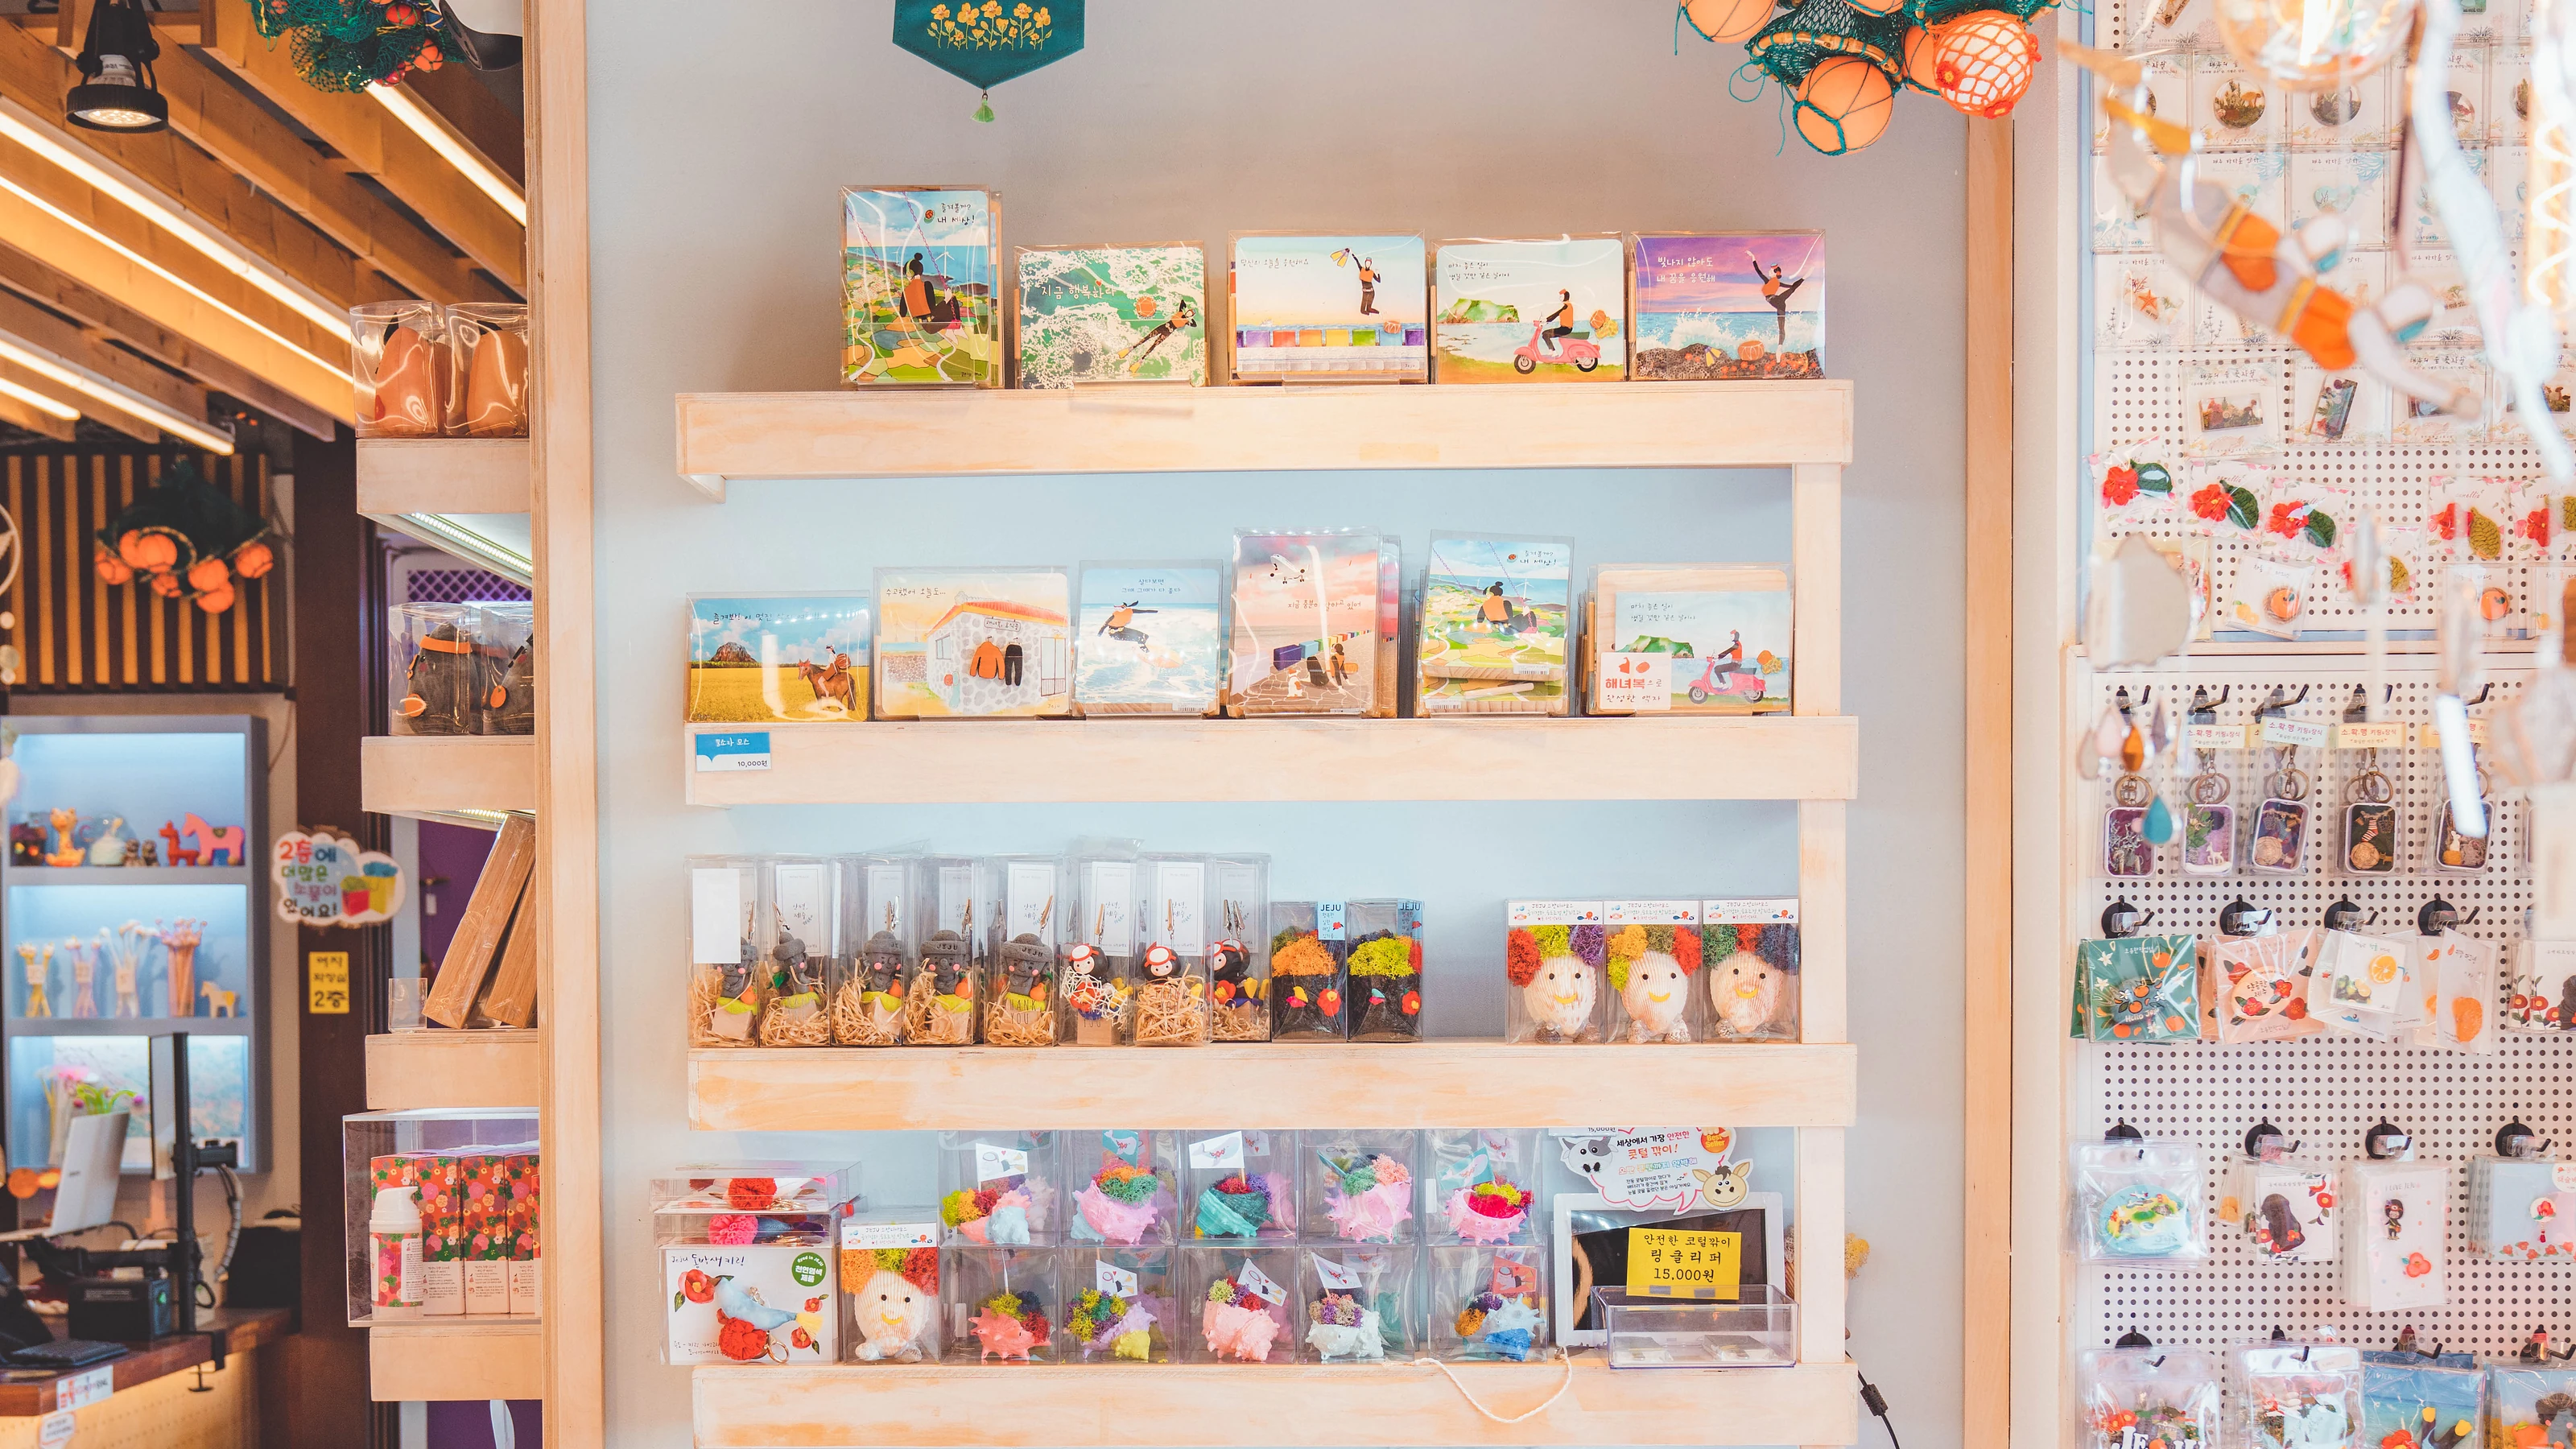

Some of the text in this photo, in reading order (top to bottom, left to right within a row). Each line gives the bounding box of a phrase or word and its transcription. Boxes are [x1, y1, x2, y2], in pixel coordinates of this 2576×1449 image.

[952, 215, 975, 226] 세상!
[1241, 258, 1309, 269] 당신의 오늘을 응원해요
[1464, 262, 1474, 270] 좋은
[1657, 256, 1714, 268] 빛나지 않아도
[1657, 272, 1715, 284] 내 꿈을 응원해
[1041, 283, 1117, 299] 지금 행복하라
[886, 588, 916, 597] 수고했어
[1288, 600, 1300, 609] 지금
[1347, 601, 1361, 610] 있어
[1648, 603, 1658, 611] 좋은
[1662, 602, 1674, 611] 일이
[756, 613, 772, 621] 멋진
[1605, 678, 1662, 690] 해녀복으로
[1607, 694, 1661, 703] 완성한 액자
[279, 838, 336, 865] 2층에
[283, 898, 336, 918] 있어요!
[1400, 902, 1421, 911] JEJU
[1022, 947, 1043, 957] JEJU
[2255, 989, 2267, 997] 제주
[315, 990, 347, 1008] 2층
[1010, 1013, 1029, 1025] YOU
[2125, 1011, 2144, 1022] Hello
[1616, 1130, 1690, 1147] 세상에서 가장 안전한
[1705, 1139, 1726, 1148] Seller
[1628, 1147, 1648, 1159] 콧털
[1671, 1157, 1698, 1168] 완벽해
[1644, 1233, 1731, 1249] 안전한 코털깎이
[671, 1255, 688, 1263] Jeju
[795, 1265, 823, 1276] 천연염색
[1653, 1268, 1715, 1283] 15,000원
[800, 1274, 815, 1282] 제품
